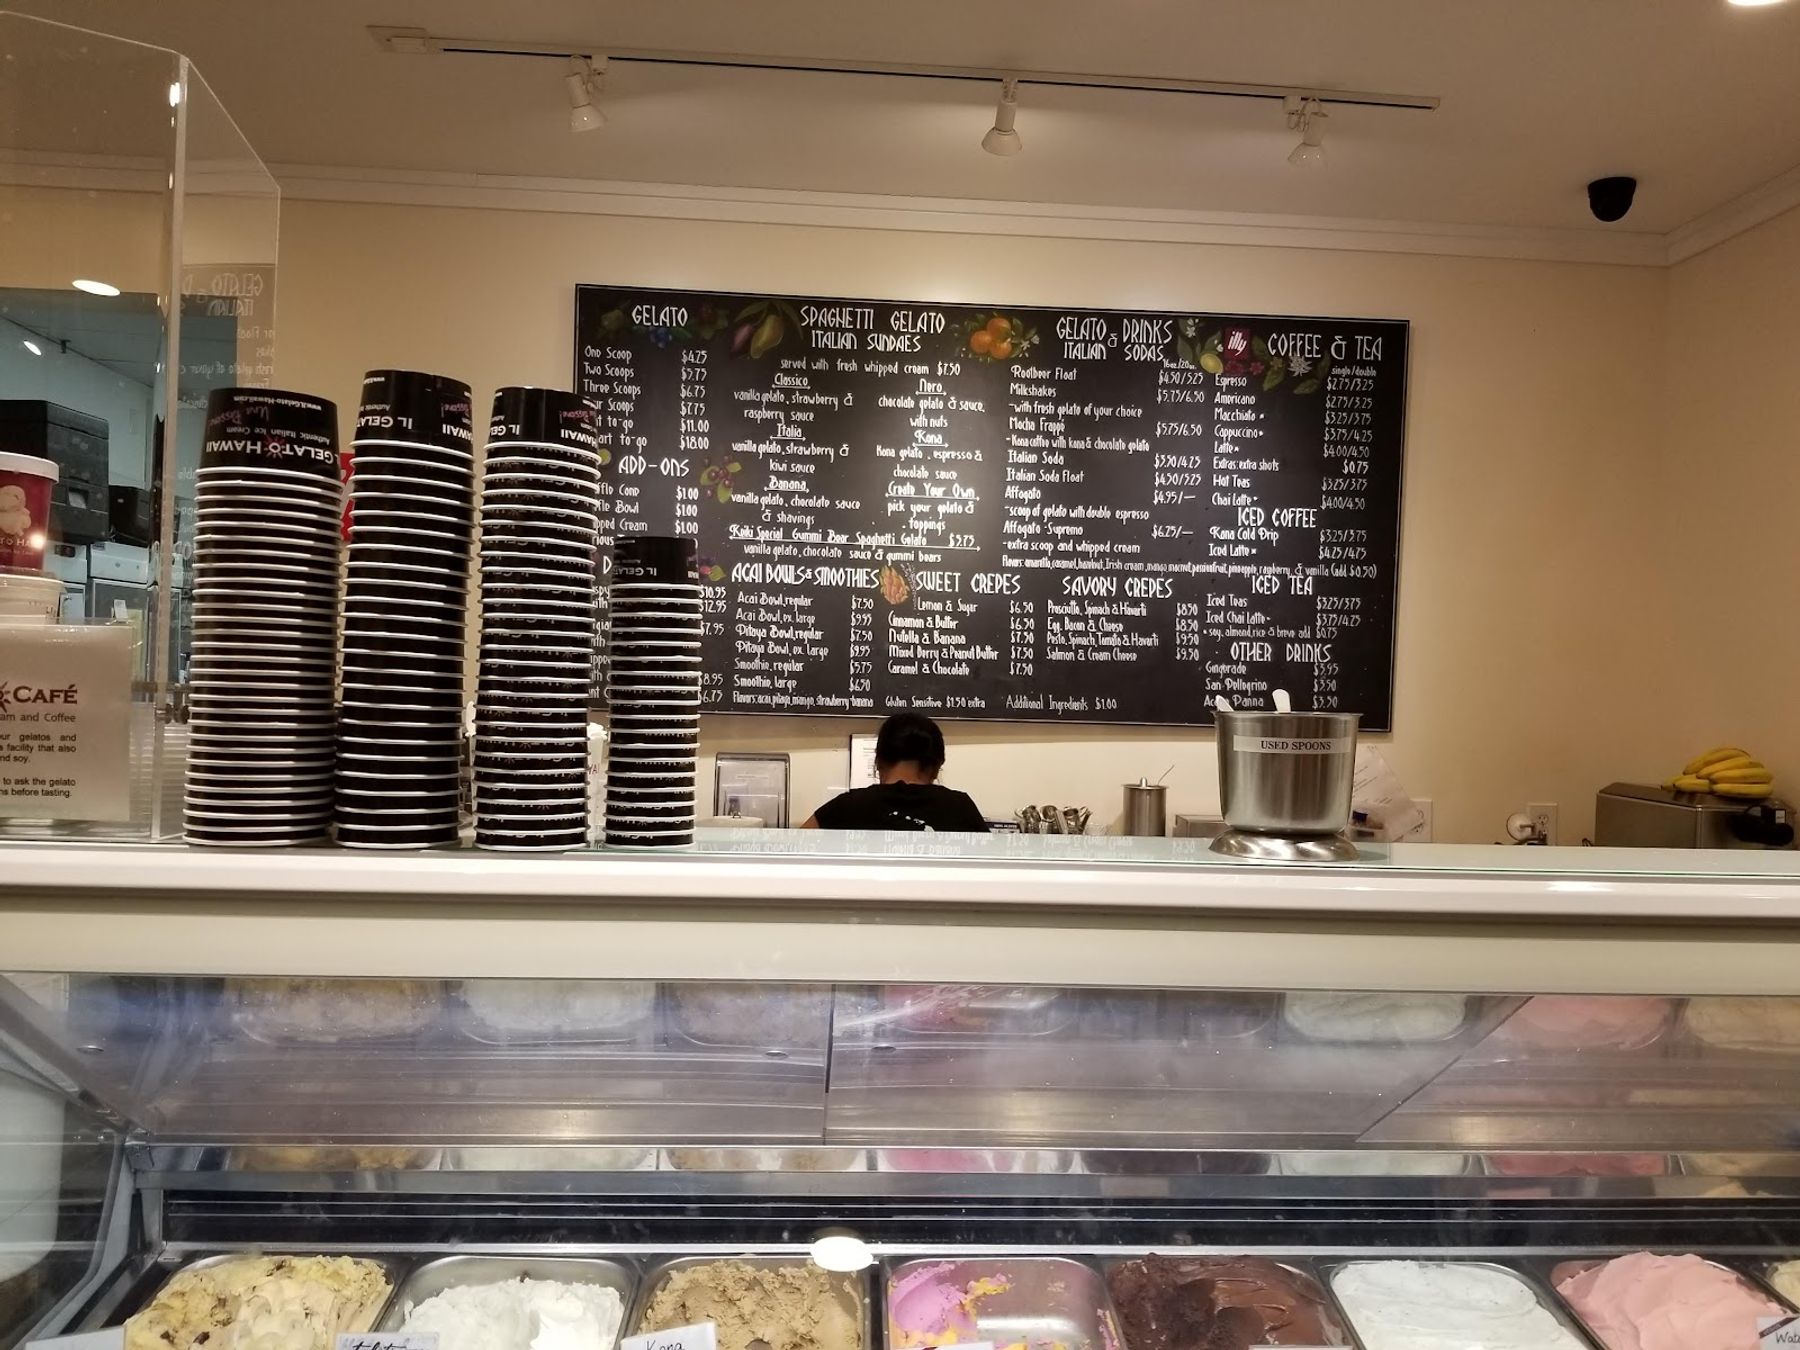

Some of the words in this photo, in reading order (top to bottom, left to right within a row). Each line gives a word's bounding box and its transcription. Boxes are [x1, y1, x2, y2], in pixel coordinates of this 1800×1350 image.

[631, 305, 688, 327] GELATO
[801, 306, 874, 329] SPAGHETTI
[890, 311, 945, 334] GELATO
[1056, 316, 1107, 340] GELATO
[1123, 318, 1173, 344] DRINKS
[812, 330, 858, 350] ITALIAN
[867, 334, 921, 353] SUNDAES
[1228, 330, 1247, 356] illy
[1267, 333, 1322, 358] COFFEE
[1355, 336, 1382, 361] TEA
[606, 347, 632, 364] Scoop
[1064, 342, 1106, 360] ITALIAN
[1124, 344, 1164, 361] SODAS
[584, 362, 601, 375] Two
[605, 364, 634, 382] Scoops
[681, 366, 707, 381] $5.75
[780, 357, 806, 370] served
[811, 359, 829, 371] with
[836, 359, 857, 372] fresh
[864, 361, 898, 377] whipped
[937, 361, 961, 376] $7.50
[1055, 367, 1077, 381] Float
[774, 374, 808, 386] Classico
[919, 379, 942, 393] Nero
[1215, 375, 1246, 392] Espresso
[583, 379, 609, 393] Three
[613, 381, 641, 399] Scoops
[680, 383, 706, 399] $6.75
[1010, 383, 1056, 398] Milkshakes
[607, 397, 634, 416] Scoops
[680, 400, 706, 416] $7.75
[791, 394, 838, 412] strawberry
[878, 395, 915, 409] chocolate
[919, 398, 944, 415] gelato
[1214, 392, 1255, 405] Americano
[744, 410, 784, 427] raspberry
[790, 412, 815, 422] sauce
[1057, 403, 1081, 420] gelato
[1115, 405, 1143, 418] choice
[1214, 408, 1256, 421] Macchiato
[226, 426, 251, 435] Cream
[254, 426, 267, 435] Ice
[397, 416, 413, 430] IL
[509, 424, 521, 436] IL
[608, 416, 633, 434] to-go
[680, 418, 709, 433] $11.00
[777, 424, 802, 437] Italia
[930, 417, 948, 428] nuts
[1009, 417, 1035, 431] Mocha
[1155, 422, 1203, 437] $5.75/6.50
[270, 428, 296, 440] Italian
[300, 431, 331, 446] Authentic
[914, 431, 942, 444] Kona
[1214, 425, 1258, 443] Cappuccino
[206, 439, 262, 455] HAWAII
[620, 434, 647, 453] to-go
[1094, 437, 1126, 450] chocolate
[269, 441, 334, 465] GELATO
[786, 444, 834, 463] strawberry
[933, 450, 972, 462] espresso
[1008, 450, 1037, 464] Italian
[1042, 451, 1064, 465] Soda
[619, 455, 690, 477] ADD-ONS
[790, 462, 815, 473] sauce
[893, 464, 929, 478] chocolate
[1343, 461, 1369, 474] $0.75
[769, 475, 806, 490] Banana
[1006, 467, 1036, 482] Italian
[1039, 469, 1059, 483] Soda
[924, 484, 945, 496] Your
[952, 484, 975, 498] Own
[1004, 485, 1041, 504] Affogato
[615, 500, 639, 514] Bowl
[790, 496, 830, 509] chocolate
[835, 499, 860, 510] sauce
[777, 511, 815, 529] shavings
[1115, 510, 1149, 525] espresso
[1238, 507, 1264, 526] ICED
[1271, 508, 1318, 528] COFFEE
[619, 518, 648, 532] Cream
[675, 520, 699, 534] $1.00
[909, 518, 946, 537] toppings
[1003, 520, 1041, 539] Affogato
[792, 528, 822, 542] Gummi
[828, 530, 849, 544] Bear
[856, 532, 895, 551] Spaghetti
[900, 534, 926, 547] Gelato
[802, 547, 842, 559] chocolate
[1030, 541, 1054, 556] scoop
[1075, 541, 1110, 557] whipped
[645, 567, 657, 577] IL
[731, 562, 762, 583] ACAI
[813, 566, 879, 588] SMOOTHIES
[916, 571, 960, 592] SWEET
[971, 573, 1021, 595] CREPES
[1062, 575, 1116, 597] SAVORY
[1124, 577, 1173, 598] CREPES
[1252, 575, 1280, 595] ICED
[1290, 576, 1313, 595] TEA
[851, 595, 873, 610] $7.50
[917, 597, 942, 611] Lemon
[957, 599, 978, 616] Sugar
[1009, 600, 1034, 614] $6.50
[1176, 602, 1198, 616] $8.50
[888, 610, 924, 629] Cinnamon
[1010, 617, 1034, 630] $6.50
[1176, 618, 1199, 632] $8.50
[735, 624, 767, 642] Pitaya
[850, 628, 873, 642] $7.50
[888, 628, 919, 644] Nutella
[933, 630, 966, 644] Banana
[1010, 631, 1034, 644] $7.50
[1176, 632, 1199, 646] $9.50
[735, 641, 765, 658] Pitaya
[888, 645, 914, 658] Mixed
[1010, 646, 1034, 660] $7.50
[1046, 648, 1075, 661] Salmon
[1176, 648, 1199, 661] $9.50
[1230, 642, 1272, 661] OTHER
[1286, 643, 1333, 663] DRINKS
[850, 660, 872, 675] $5.75
[888, 660, 918, 675] Caramel
[932, 661, 970, 675] Chocolate
[1009, 661, 1033, 675] $7.50
[1205, 660, 1247, 679] Gingerade
[13, 684, 78, 705] CAFÉ
[1224, 679, 1267, 695] Pellegrino
[1313, 679, 1336, 693] $3.50
[1006, 694, 1043, 709] Additional
[1049, 696, 1088, 714] Ingredients
[1232, 694, 1264, 708] Panna
[20, 713, 39, 722] and
[44, 713, 76, 723] Coffee
[19, 733, 51, 742] gelatos
[60, 734, 77, 742] and
[1261, 740, 1288, 750] USED
[1292, 741, 1331, 750] SPOONS
[7, 743, 34, 754] facility
[38, 744, 54, 753] that
[58, 744, 77, 753] also
[13, 755, 31, 764] soy.
[3, 777, 12, 785] to
[14, 777, 30, 786] ask
[32, 777, 46, 786] the
[49, 777, 76, 787] gelato
[11, 788, 39, 796] before
[41, 788, 72, 798] tasting.
